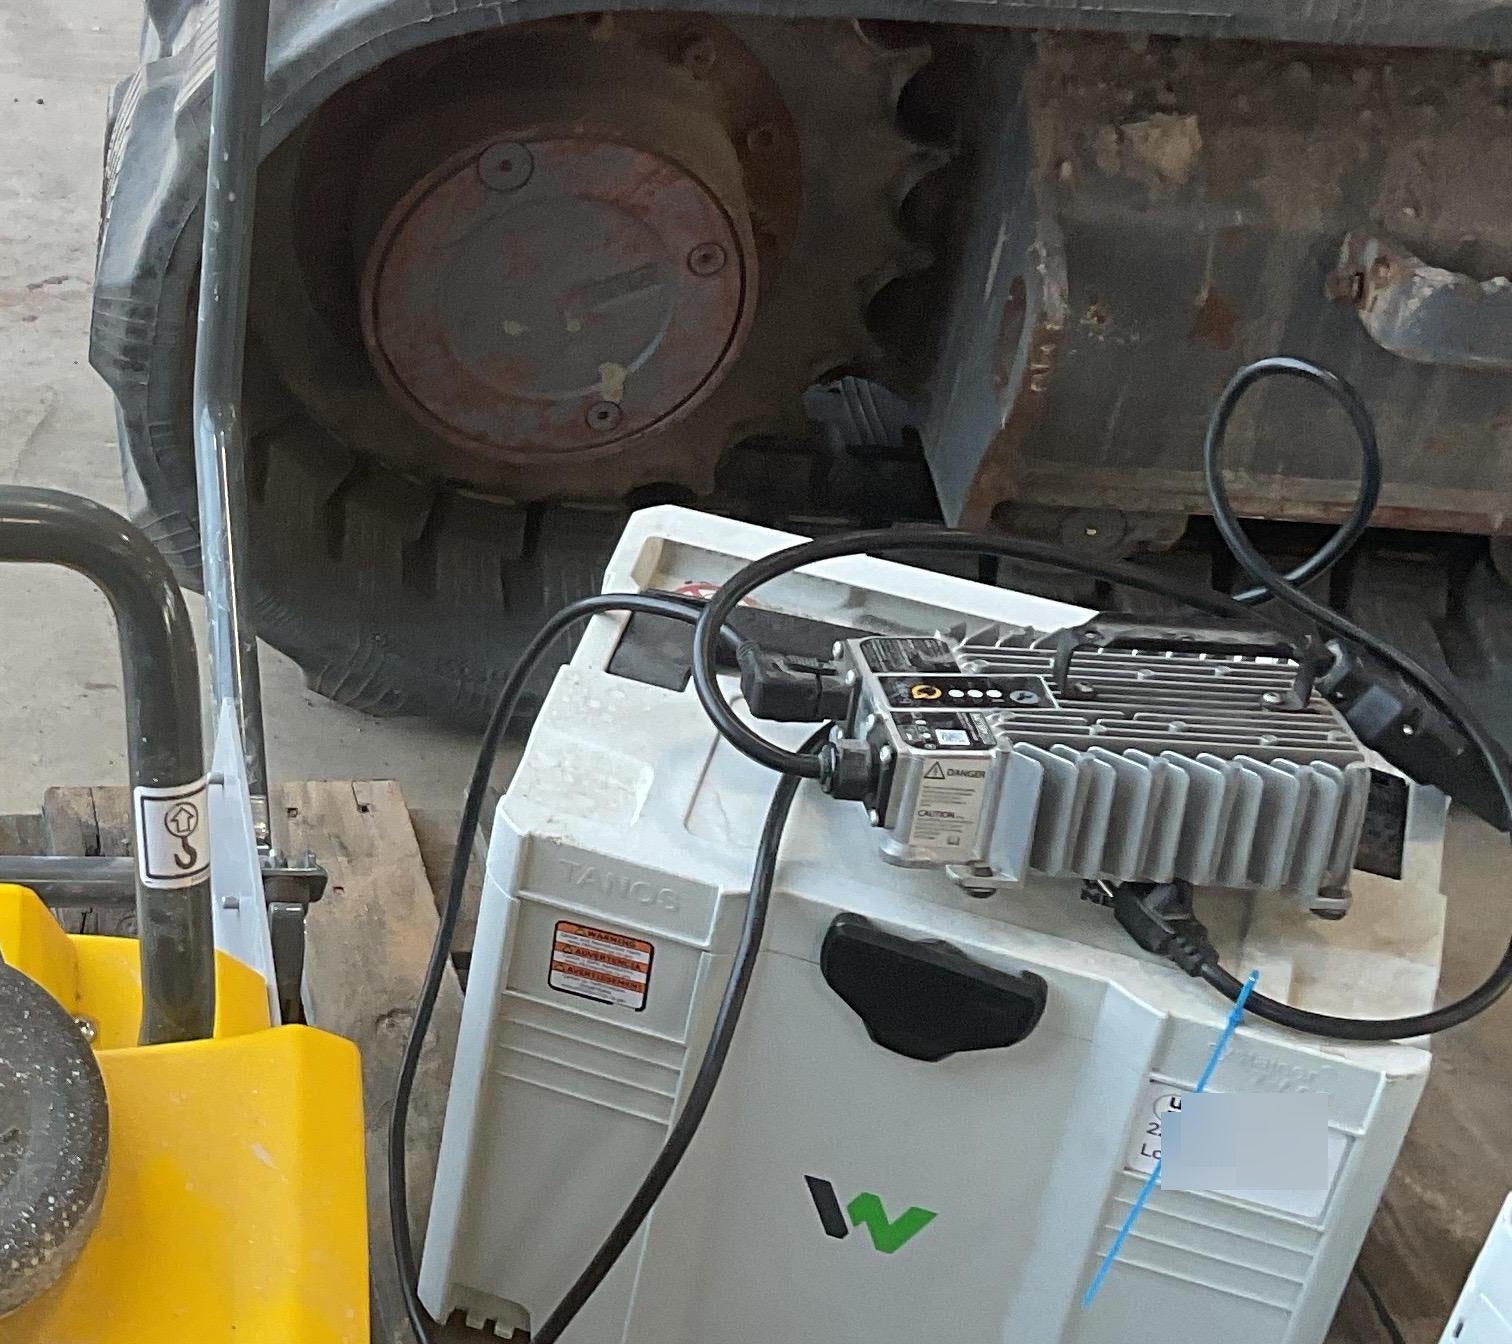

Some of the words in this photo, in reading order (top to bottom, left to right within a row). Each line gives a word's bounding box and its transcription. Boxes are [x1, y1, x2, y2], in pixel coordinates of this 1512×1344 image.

[946, 768, 986, 778] DANGER
[917, 809, 955, 819] CAUTION
[559, 857, 679, 912] TANOS
[587, 930, 636, 948] WARNING
